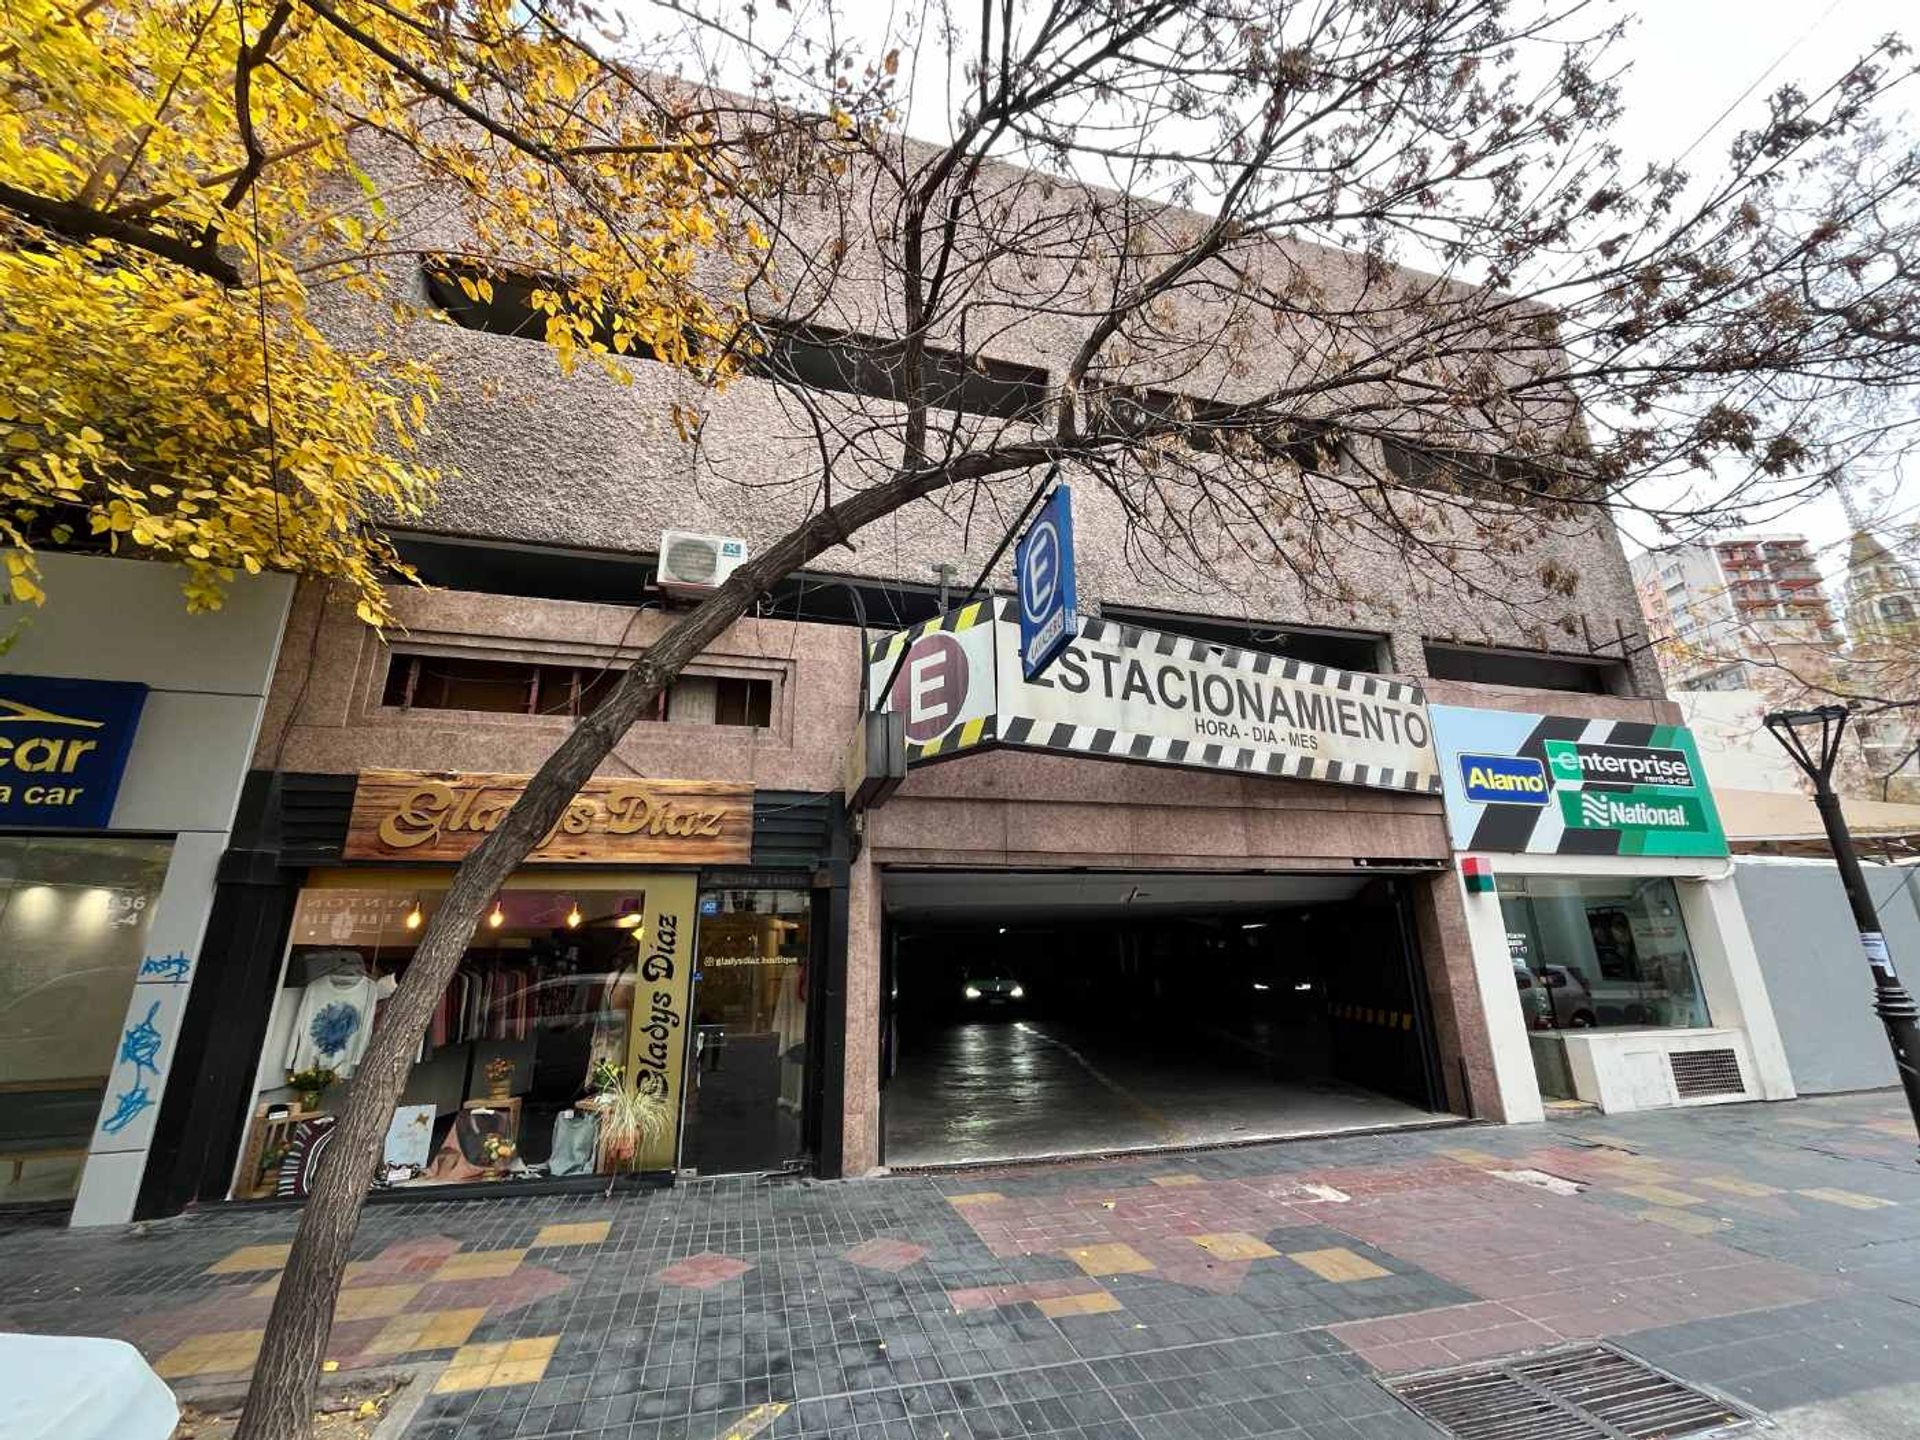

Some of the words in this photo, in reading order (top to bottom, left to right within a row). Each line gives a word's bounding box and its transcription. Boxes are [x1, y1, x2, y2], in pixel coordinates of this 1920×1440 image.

[1030, 535, 1049, 611] E
[911, 651, 949, 724] E
[1195, 718, 1241, 738] HORA
[1289, 732, 1318, 751] MES
[1468, 767, 1544, 793] Alamo
[1552, 750, 1688, 779] enterprise
[1644, 775, 1691, 785] rent-a-car
[24, 786, 84, 805] car
[603, 783, 727, 837] Diaz
[641, 914, 677, 983] Diaz
